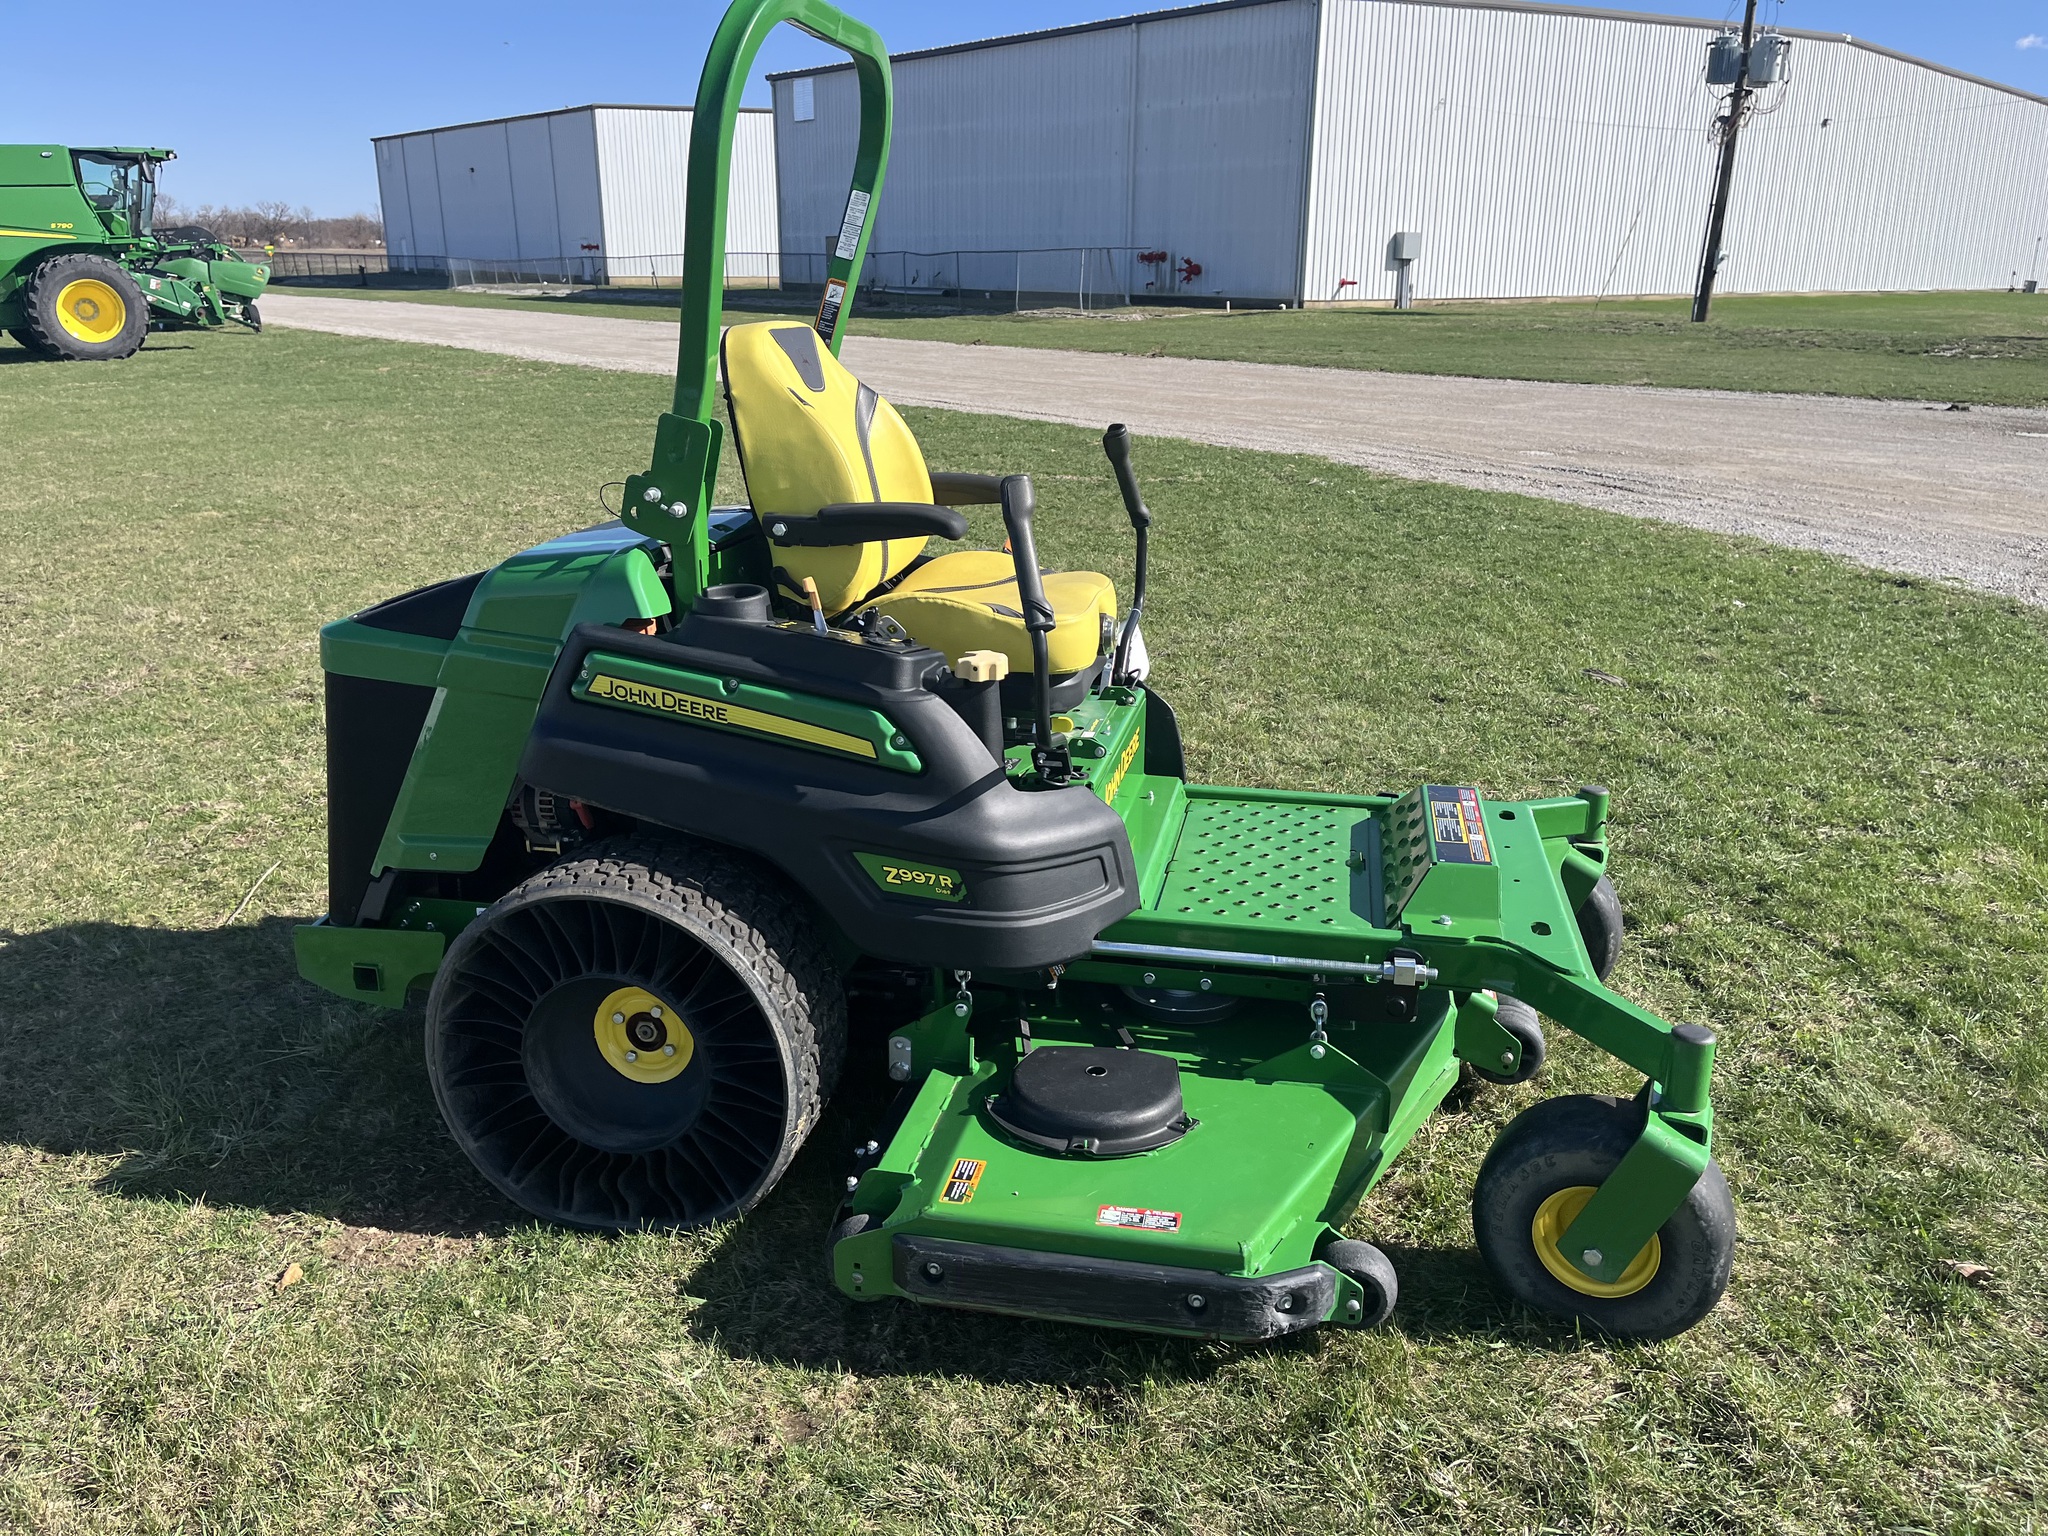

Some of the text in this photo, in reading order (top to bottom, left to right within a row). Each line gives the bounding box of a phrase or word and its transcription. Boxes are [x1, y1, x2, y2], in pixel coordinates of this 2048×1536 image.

[603, 680, 729, 722] JOHN DEERE
[1120, 726, 1140, 782] DEERE
